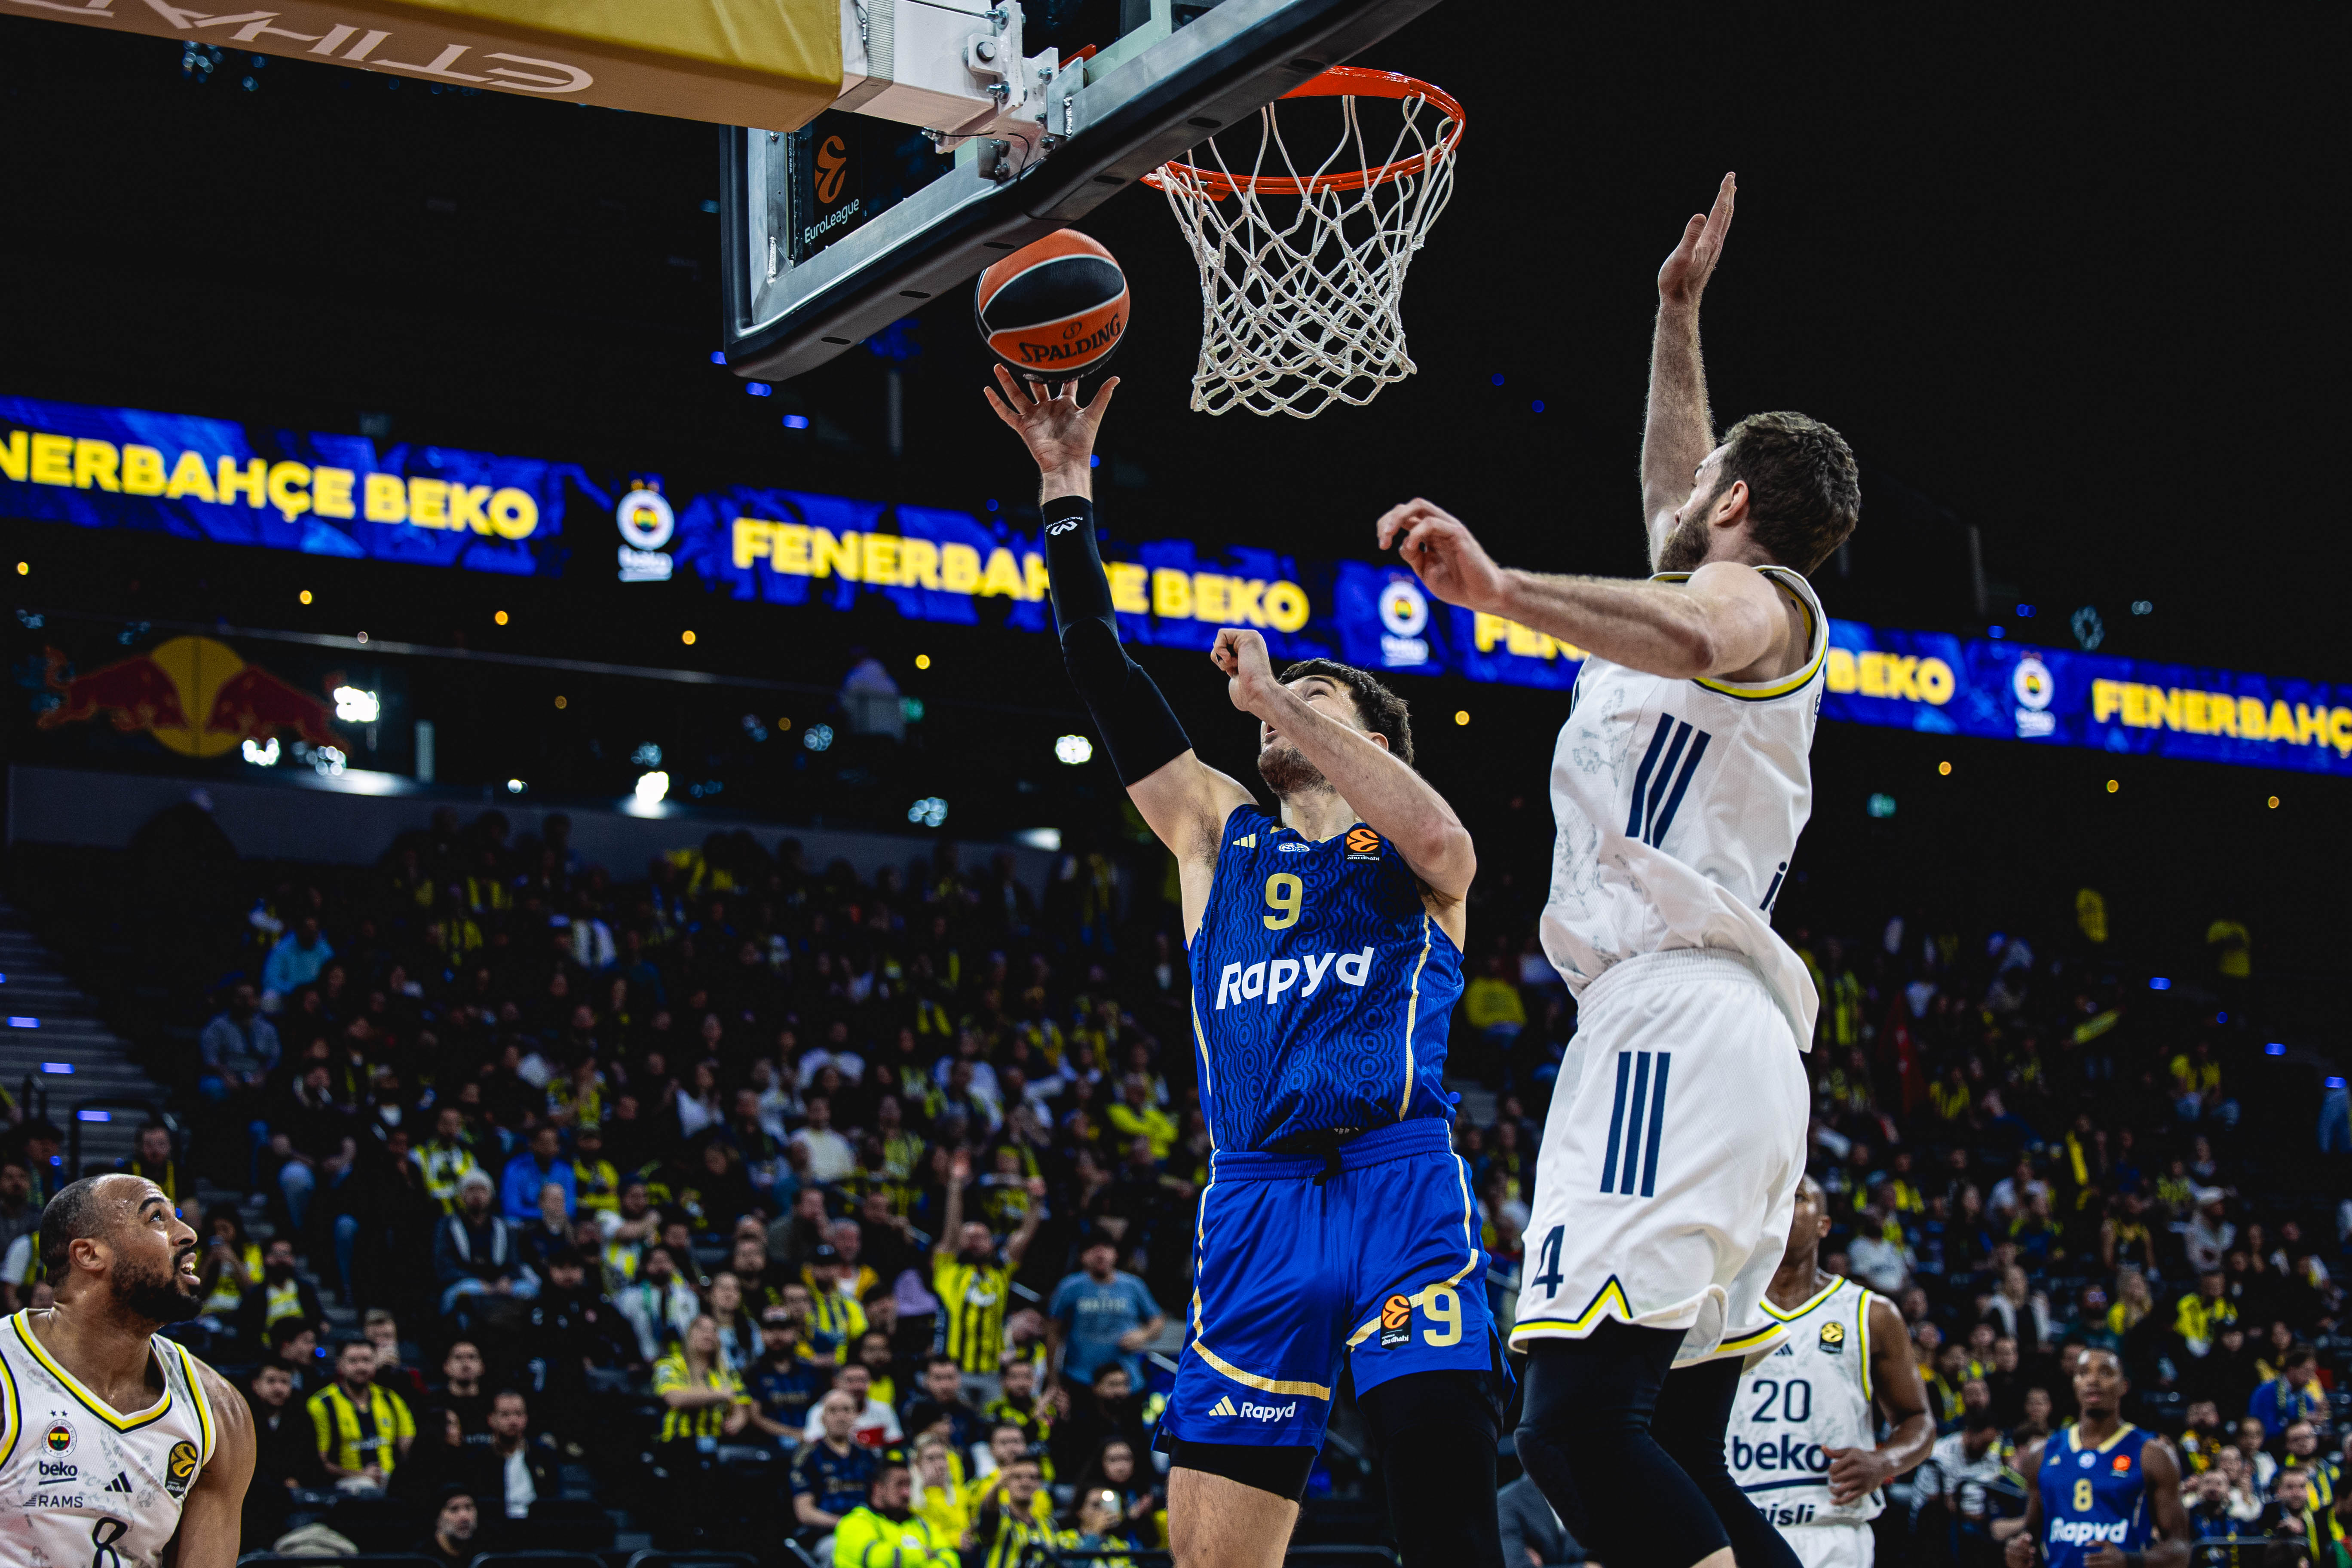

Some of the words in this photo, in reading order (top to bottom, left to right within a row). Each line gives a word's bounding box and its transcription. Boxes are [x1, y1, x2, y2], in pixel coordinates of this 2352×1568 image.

[805, 199, 859, 244] EuroLeague
[1019, 313, 1121, 363] SPALDING
[364, 472, 538, 539] BEKO
[732, 517, 1149, 615] FENERBAHE
[1152, 568, 1310, 632] BEKO
[1825, 647, 1955, 705] BEKO
[1264, 873, 1303, 930] 9
[1216, 946, 1375, 1010] Rapyd
[1531, 1225, 1565, 1299] 4
[1423, 1284, 1462, 1348] 9
[1240, 1401, 1296, 1422] Rapyd
[1752, 1379, 1812, 1423] 20
[39, 1461, 78, 1476] beko
[1733, 1434, 1831, 1473] beko
[39, 1495, 83, 1508] RAMS
[2073, 1479, 2093, 1512] 8
